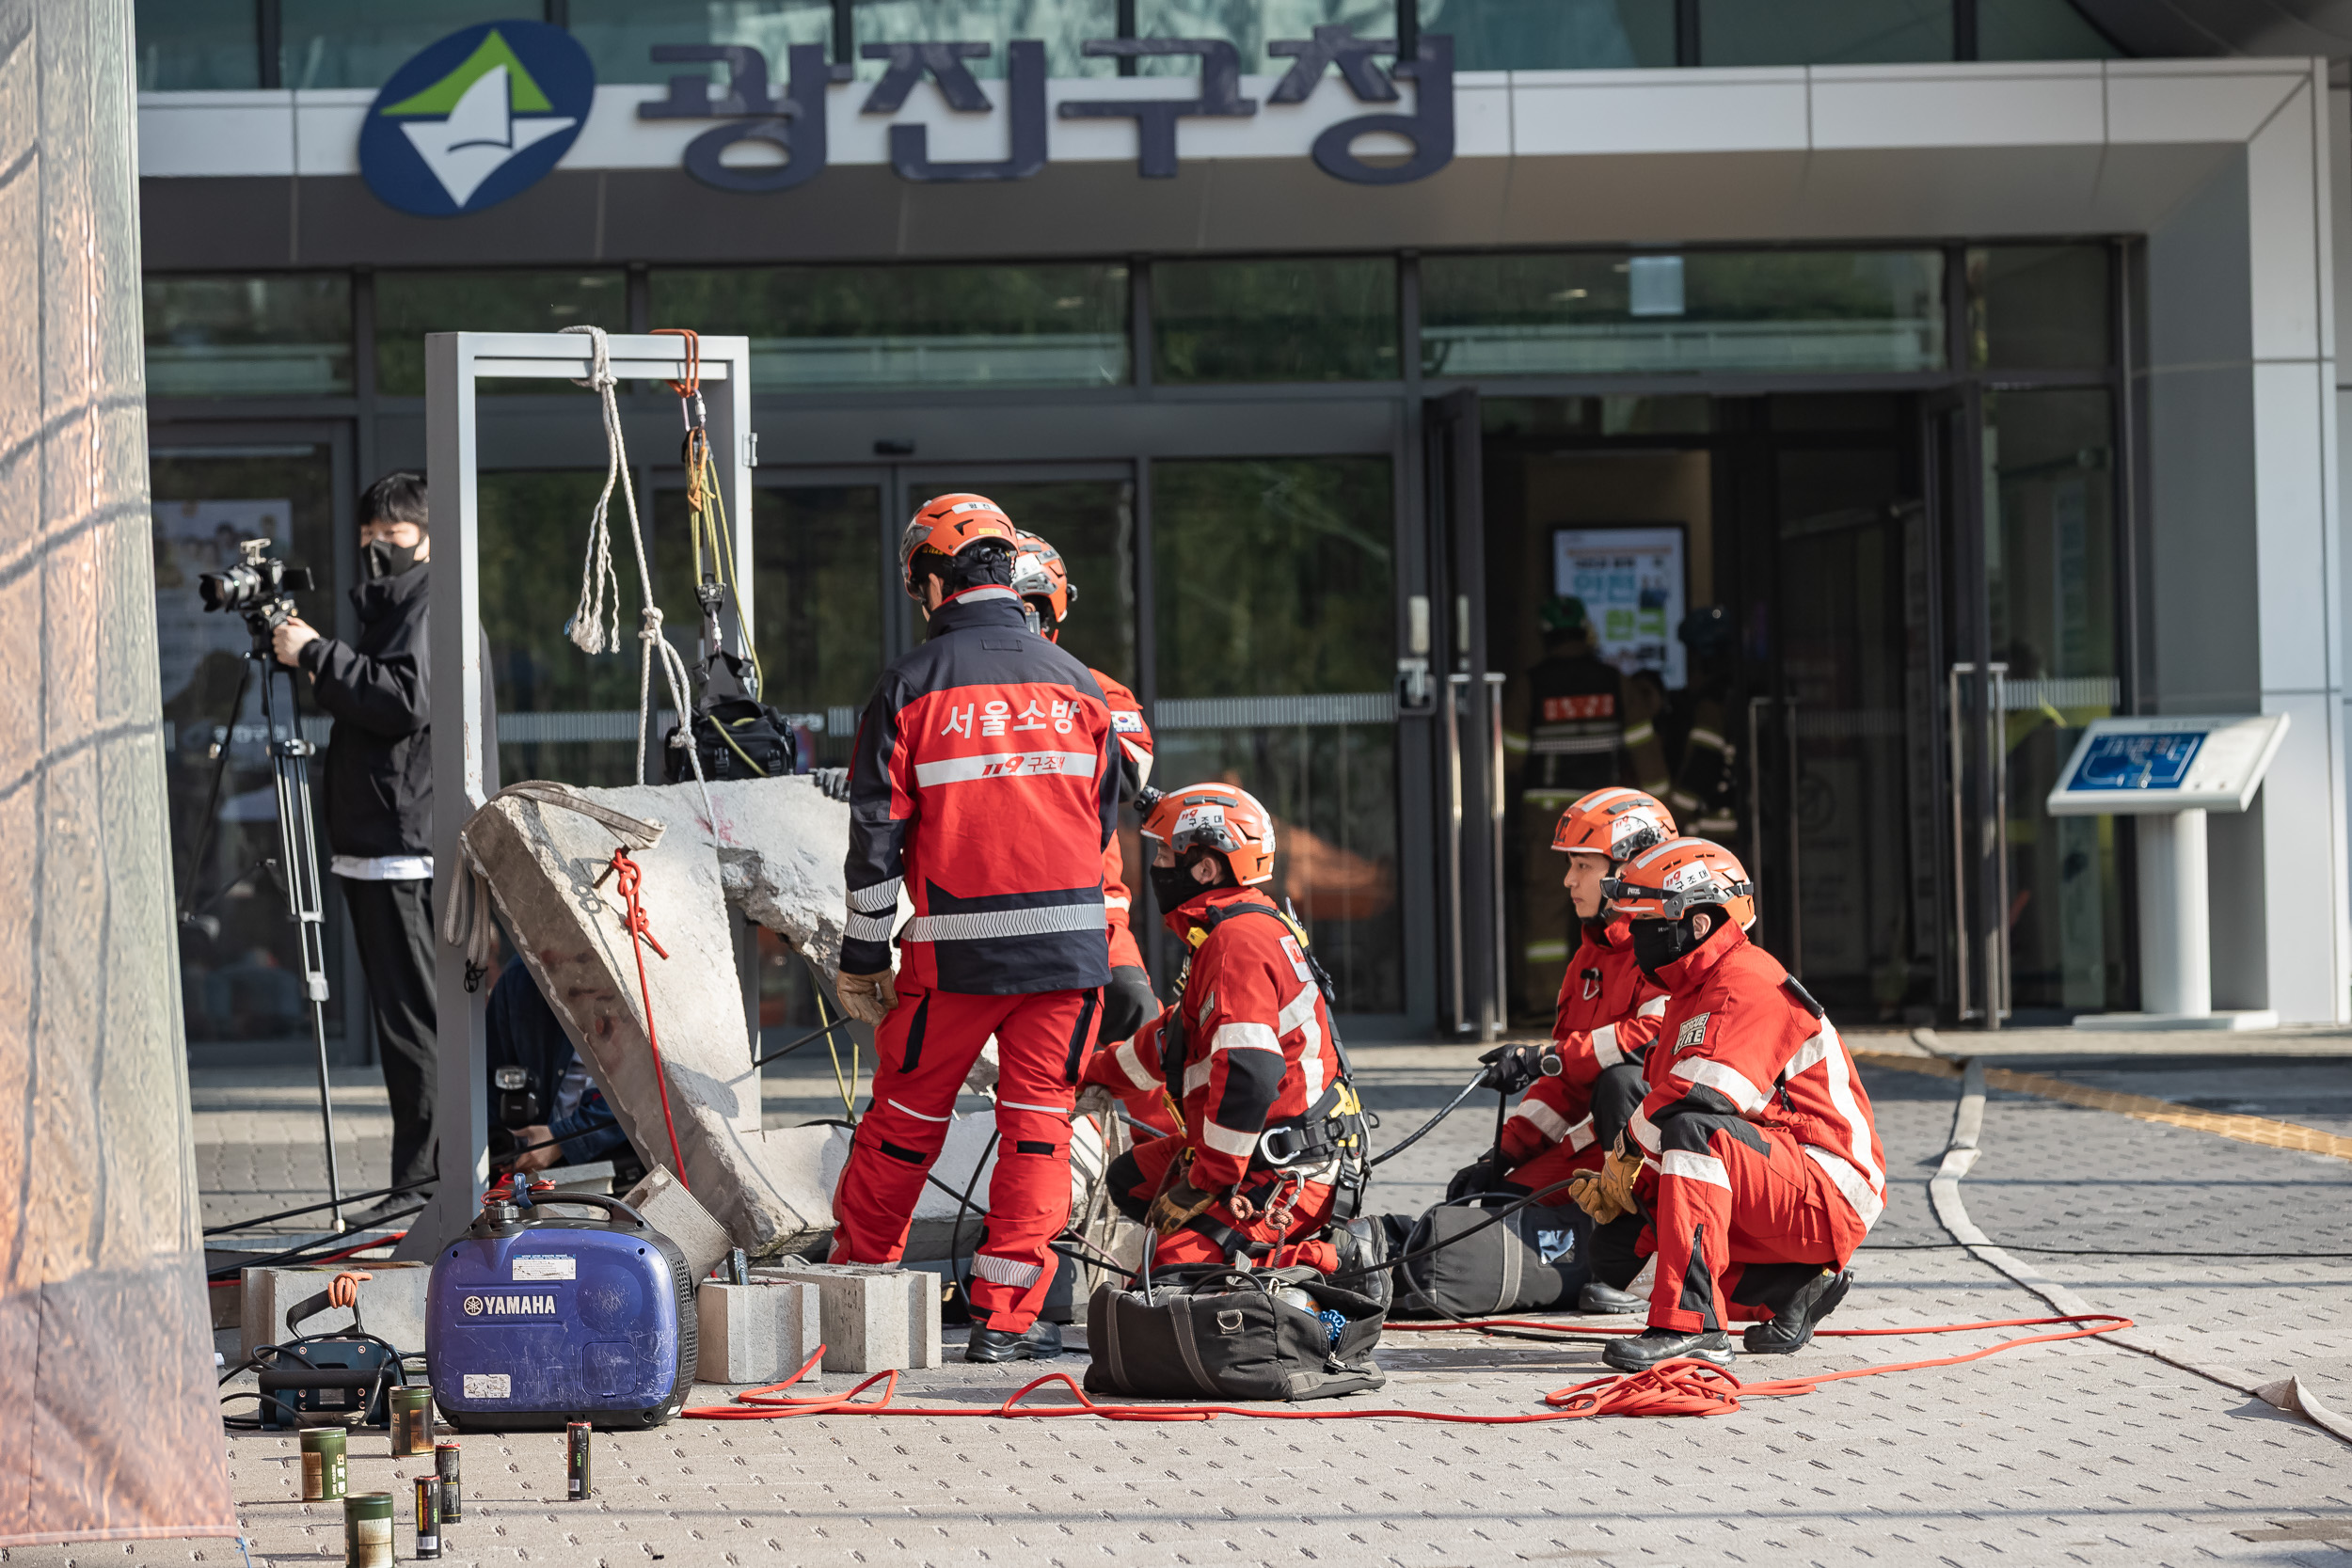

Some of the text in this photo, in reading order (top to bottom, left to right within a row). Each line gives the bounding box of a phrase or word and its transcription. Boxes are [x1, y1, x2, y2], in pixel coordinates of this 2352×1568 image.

[637, 24, 1457, 190] 광진구청
[941, 699, 1081, 739] 서울소방
[981, 755, 1025, 777] 119
[1181, 809, 1199, 820] 119
[1665, 869, 1708, 890] 119 구조대
[1675, 1029, 1703, 1051] FIRE
[484, 1295, 556, 1315] YAMAHA
